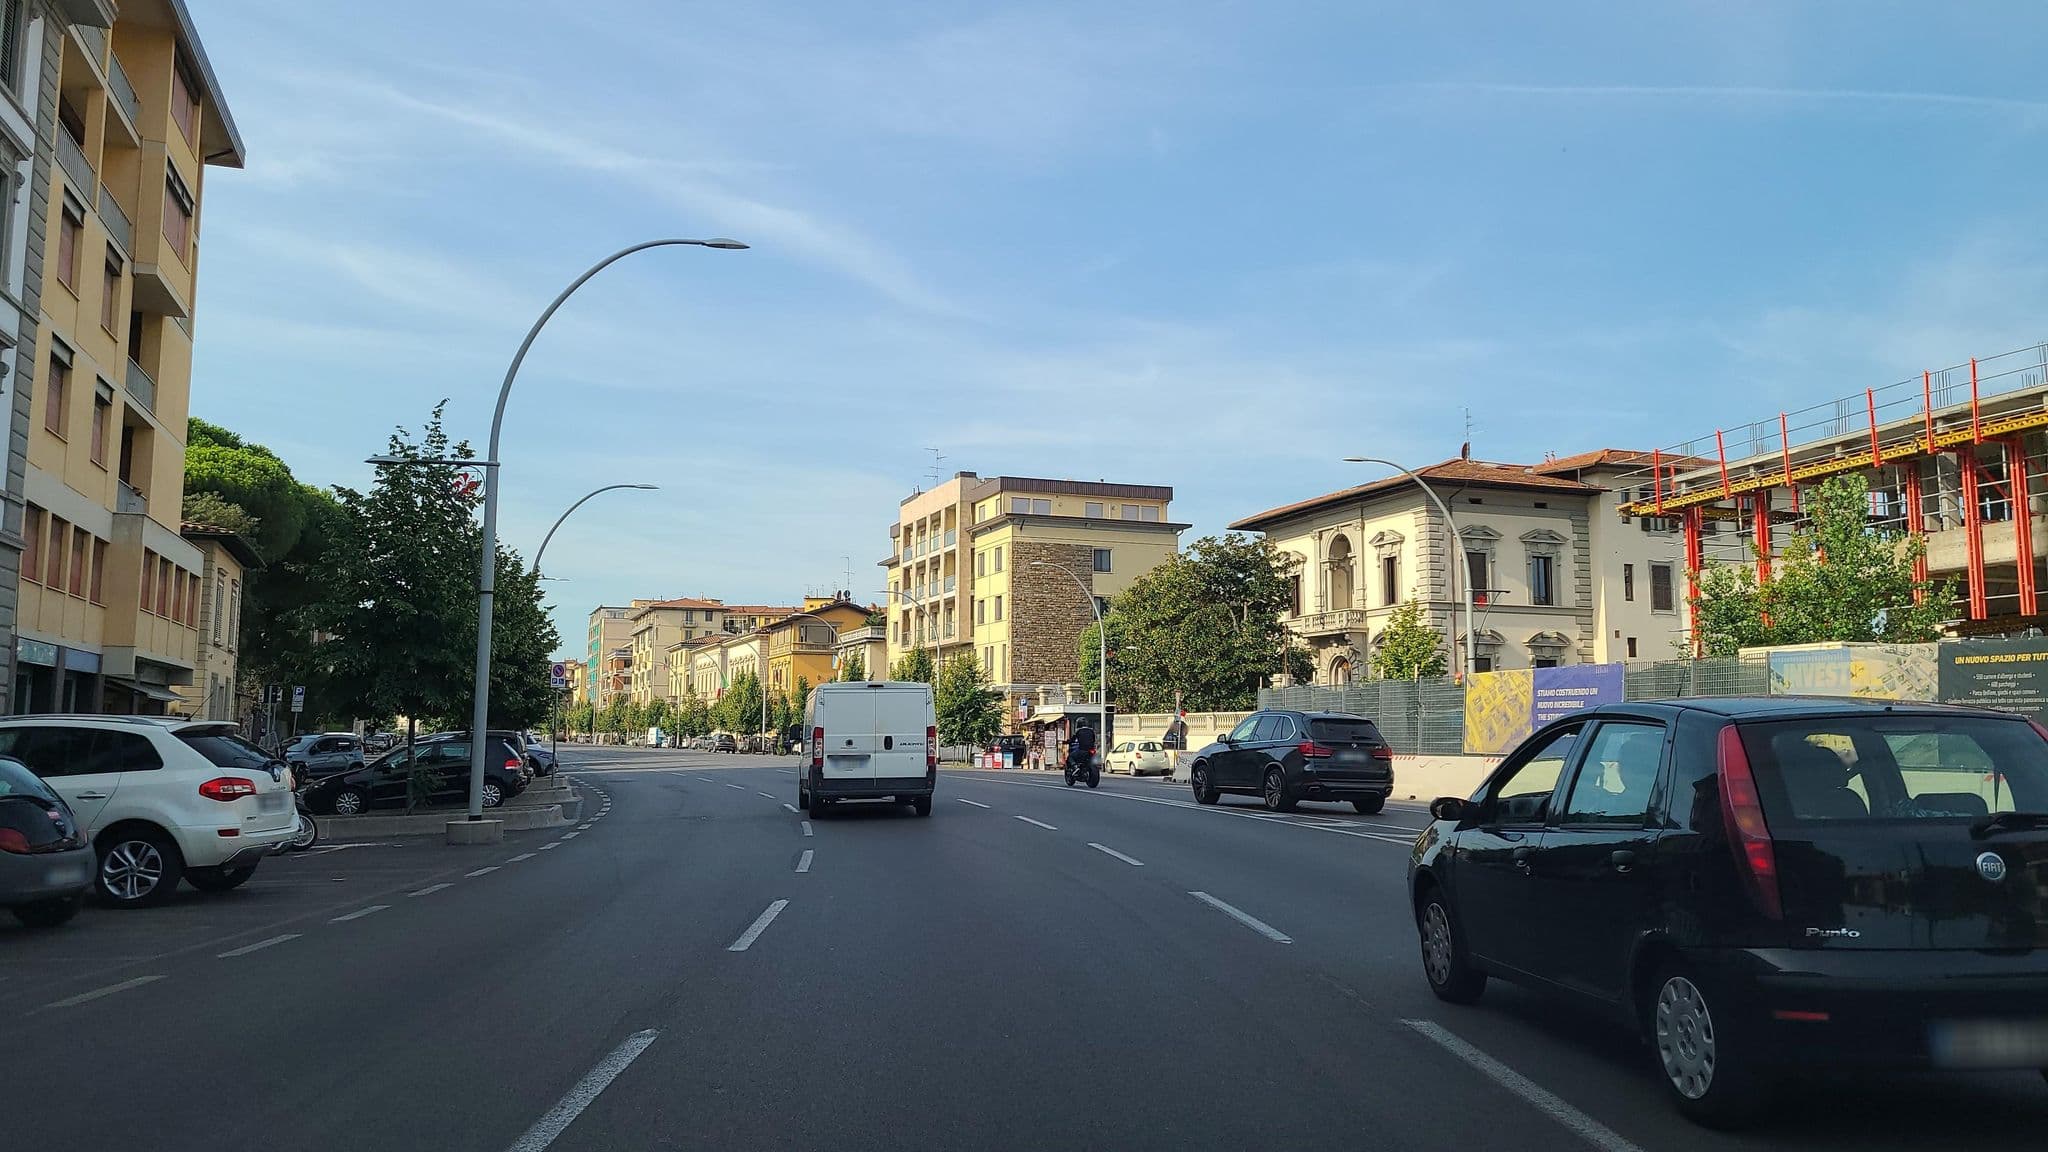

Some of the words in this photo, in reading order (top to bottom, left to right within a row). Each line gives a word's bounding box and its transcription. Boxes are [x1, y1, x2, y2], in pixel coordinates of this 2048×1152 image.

[1955, 656, 1965, 664] UN
[1965, 655, 1990, 664] NUOVO
[1990, 654, 2016, 663] SPAZIO
[2016, 653, 2031, 662] PER
[1982, 862, 2001, 872] FIAT
[1805, 927, 1860, 938] Punto
